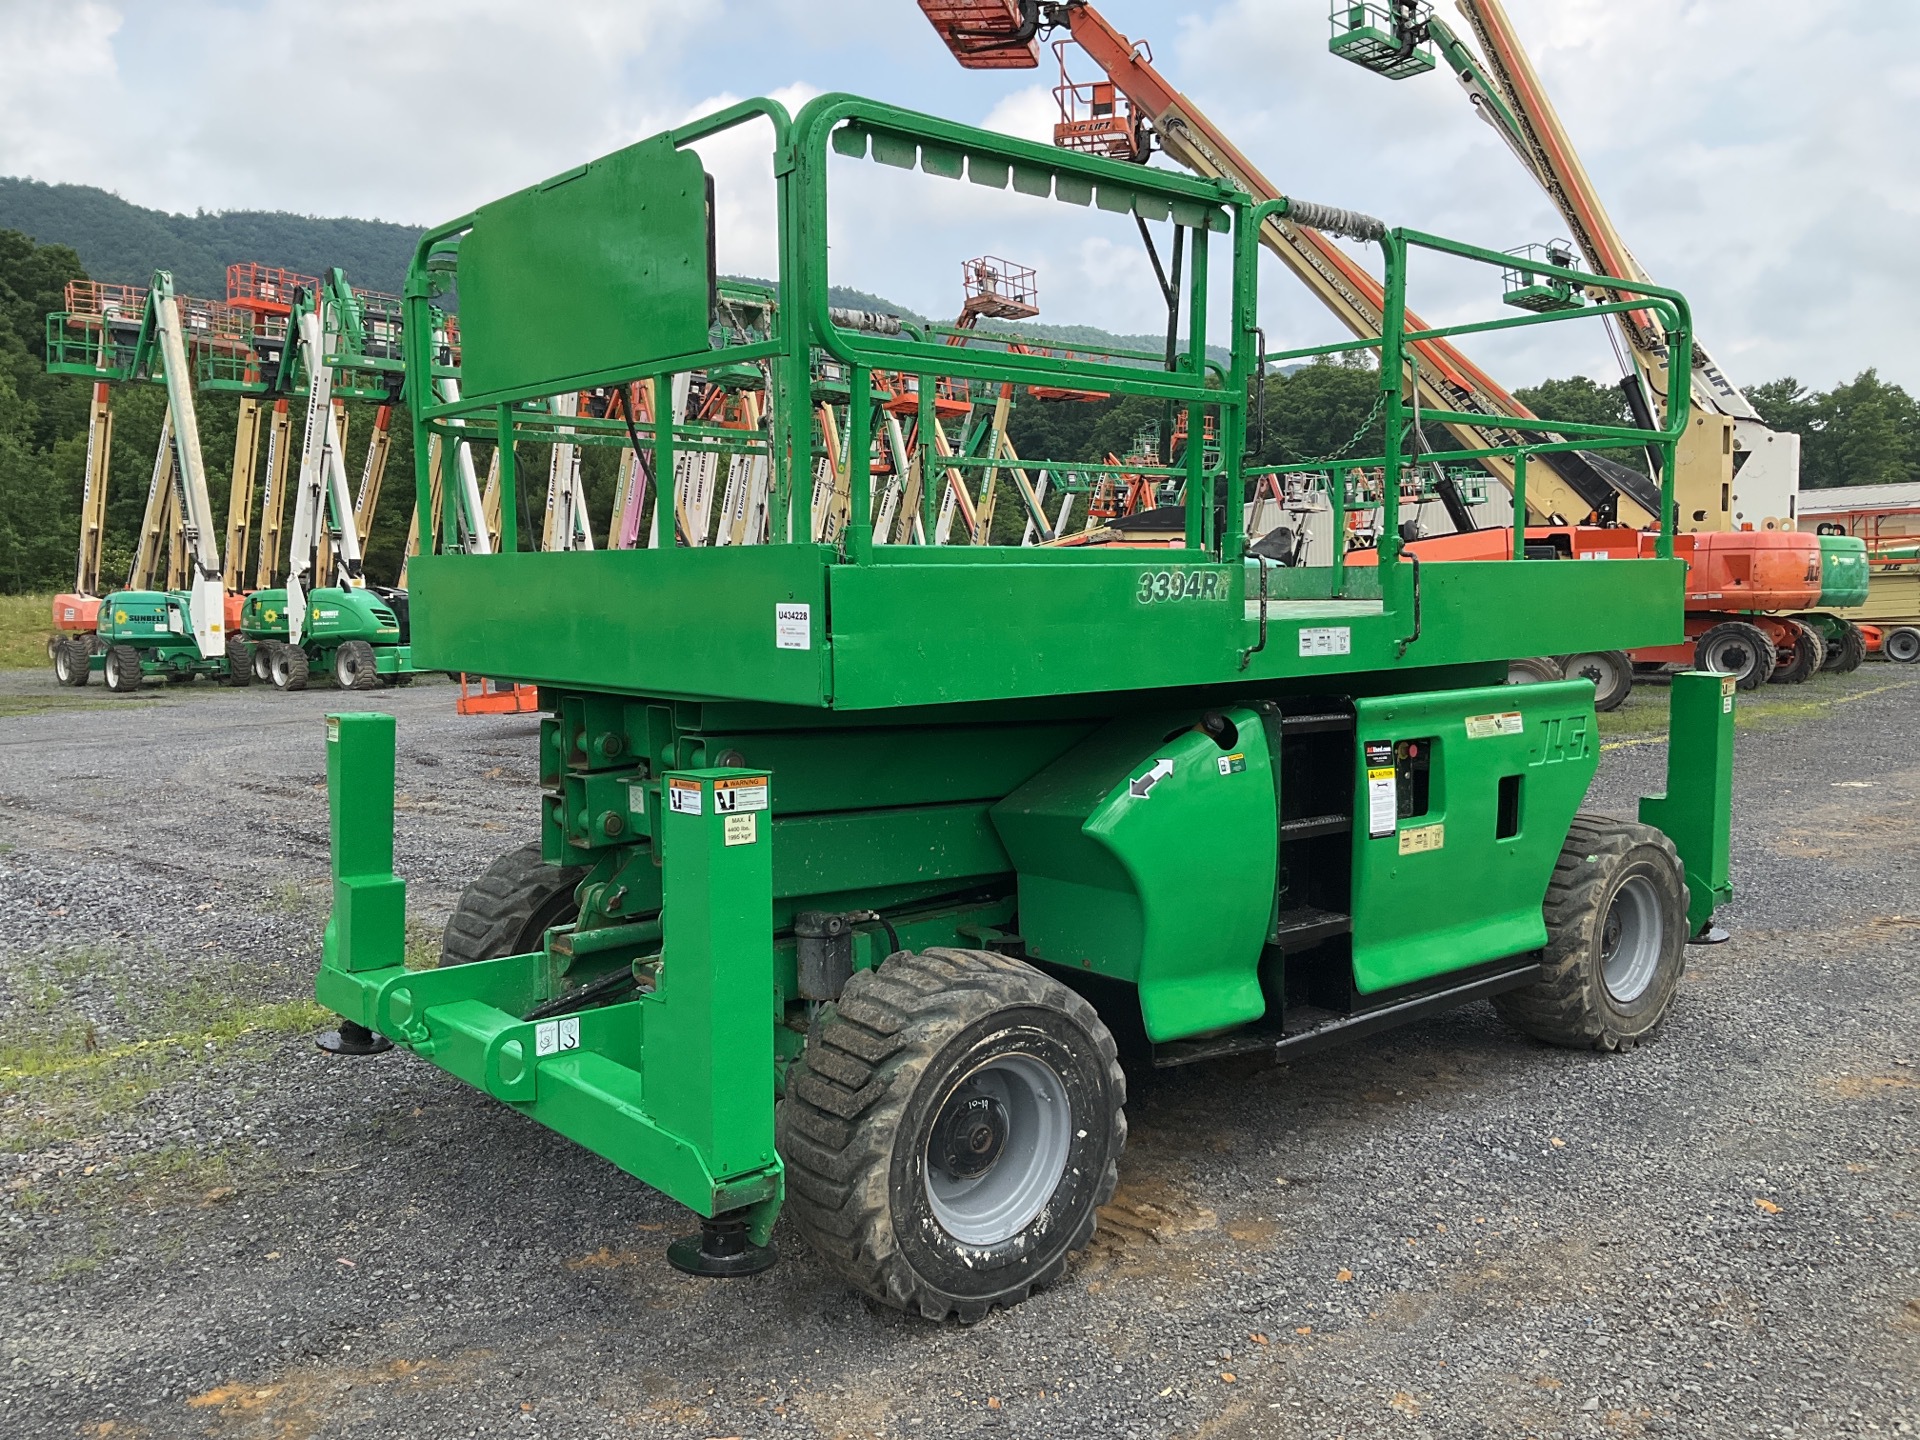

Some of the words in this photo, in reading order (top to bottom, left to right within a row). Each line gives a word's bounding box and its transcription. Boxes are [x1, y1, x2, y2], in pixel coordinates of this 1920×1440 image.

[1088, 121, 1111, 131] LIFT
[1703, 367, 1735, 396] LIFT
[305, 416, 313, 454] SUNBELT
[309, 374, 318, 414] RENTALS
[840, 429, 850, 463] SUNBELT
[943, 489, 952, 512] SUNBELT
[827, 513, 836, 537] LIFT
[896, 519, 905, 542] LIFT
[972, 523, 980, 544] LIFT
[778, 611, 808, 620] U434228
[1528, 714, 1587, 767] JLG
